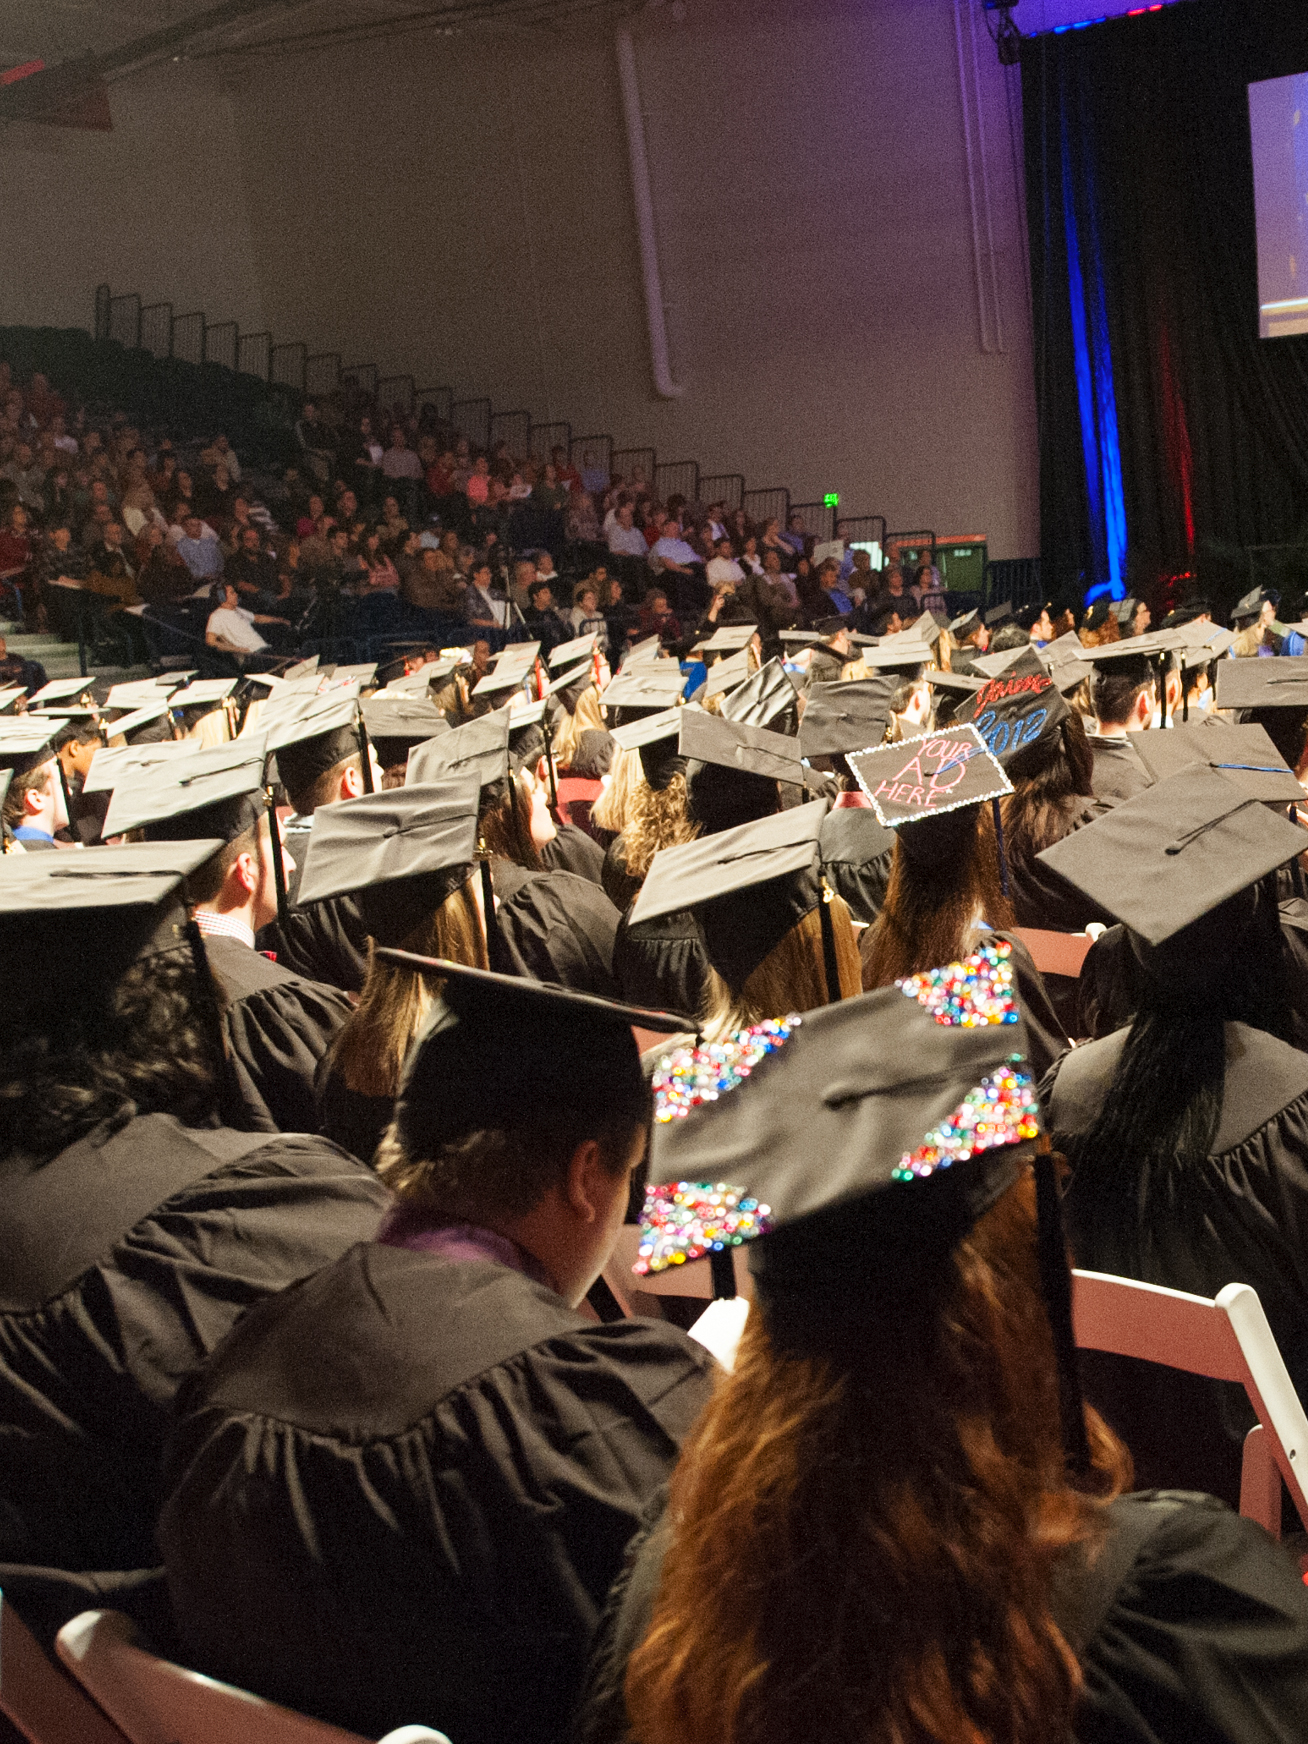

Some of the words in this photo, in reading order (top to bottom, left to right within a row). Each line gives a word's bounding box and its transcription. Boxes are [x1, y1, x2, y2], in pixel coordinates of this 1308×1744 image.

[976, 708, 1047, 756] 2012
[916, 738, 973, 760] YOUR
[892, 756, 966, 791] AD
[874, 780, 945, 808] HERE
